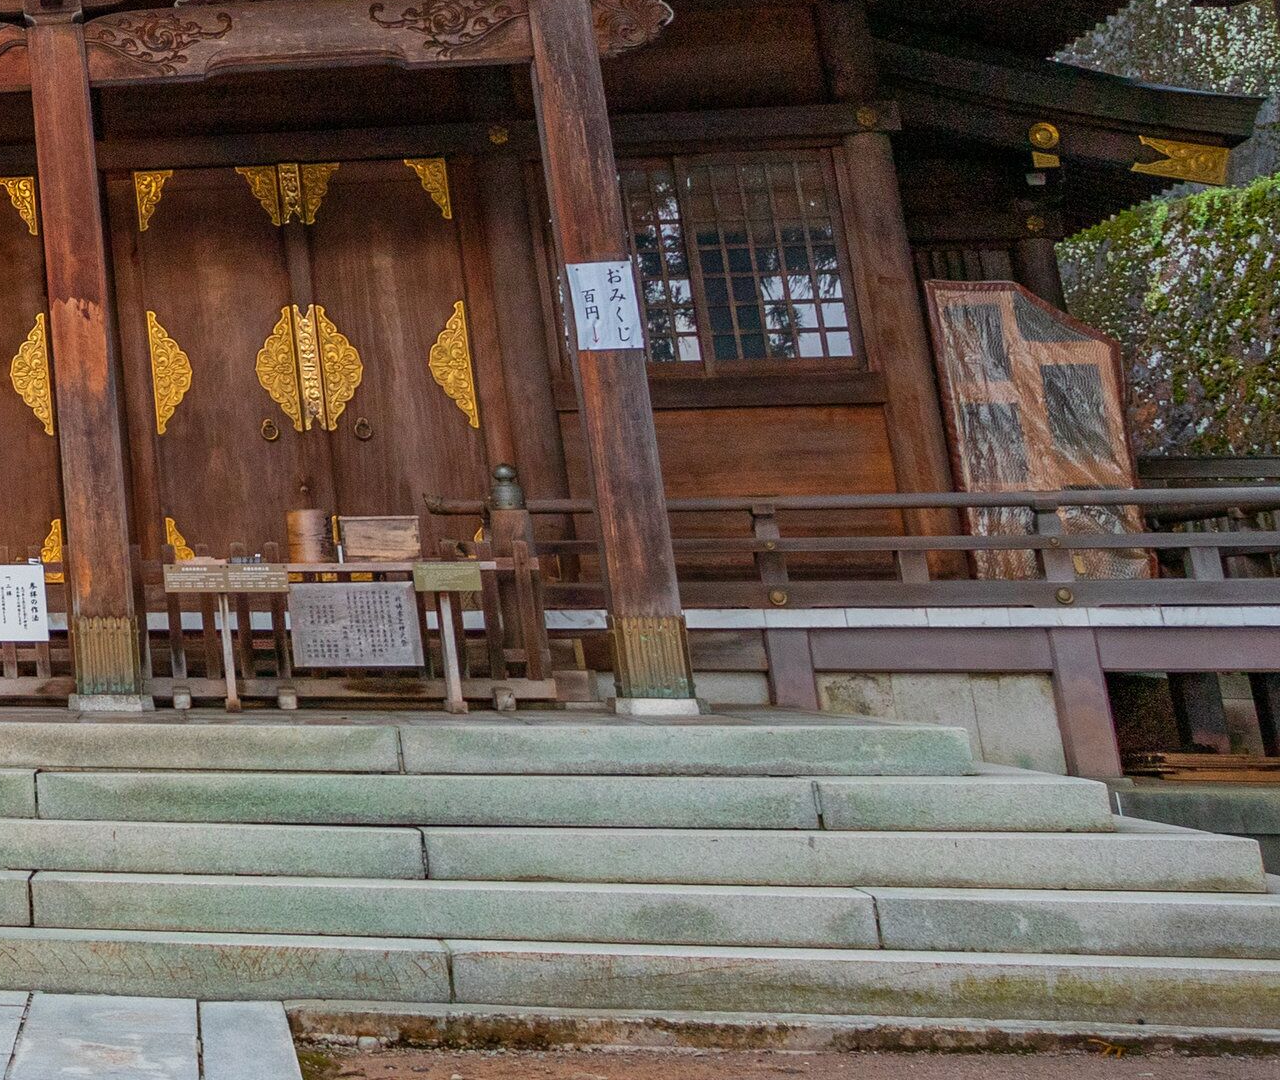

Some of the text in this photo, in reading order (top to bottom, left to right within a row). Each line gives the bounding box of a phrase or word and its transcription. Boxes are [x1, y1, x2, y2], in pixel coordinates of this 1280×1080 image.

[582, 288, 600, 320] 百円
[607, 268, 630, 342] おみくじ
